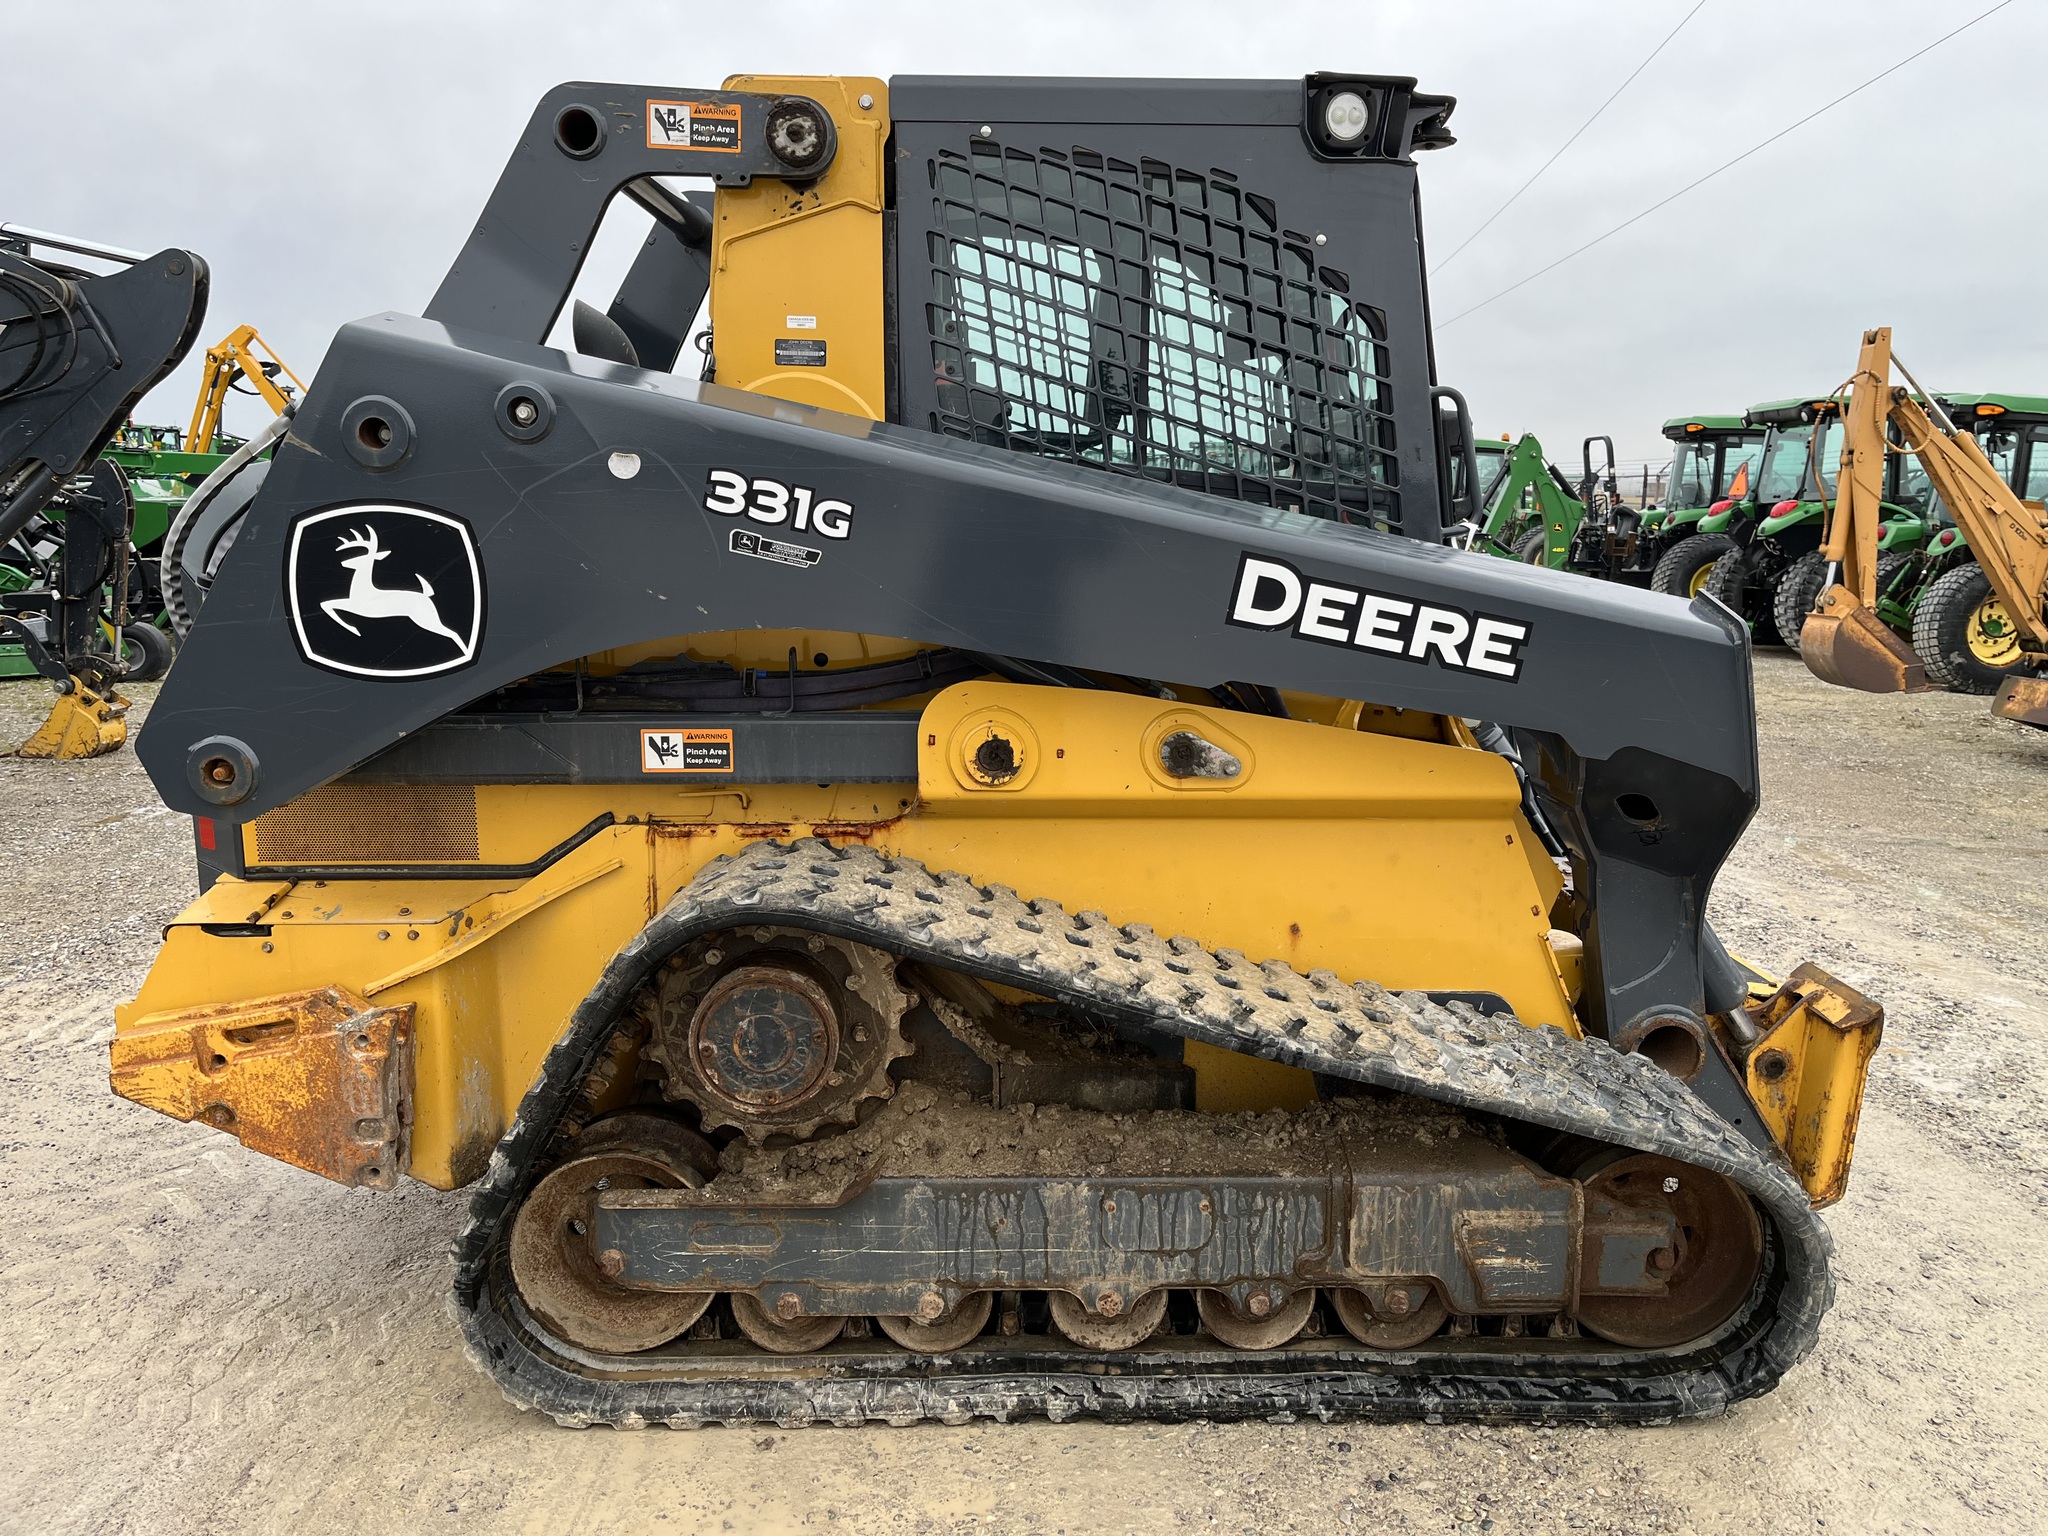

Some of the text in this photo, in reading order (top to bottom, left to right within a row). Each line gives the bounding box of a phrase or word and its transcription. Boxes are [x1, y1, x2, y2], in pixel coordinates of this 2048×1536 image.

[701, 107, 737, 116] WARNING
[693, 124, 735, 134] Pinch Area
[693, 134, 729, 144] Keep Away
[705, 469, 852, 539] 331G
[1231, 557, 1527, 677] DEERE
